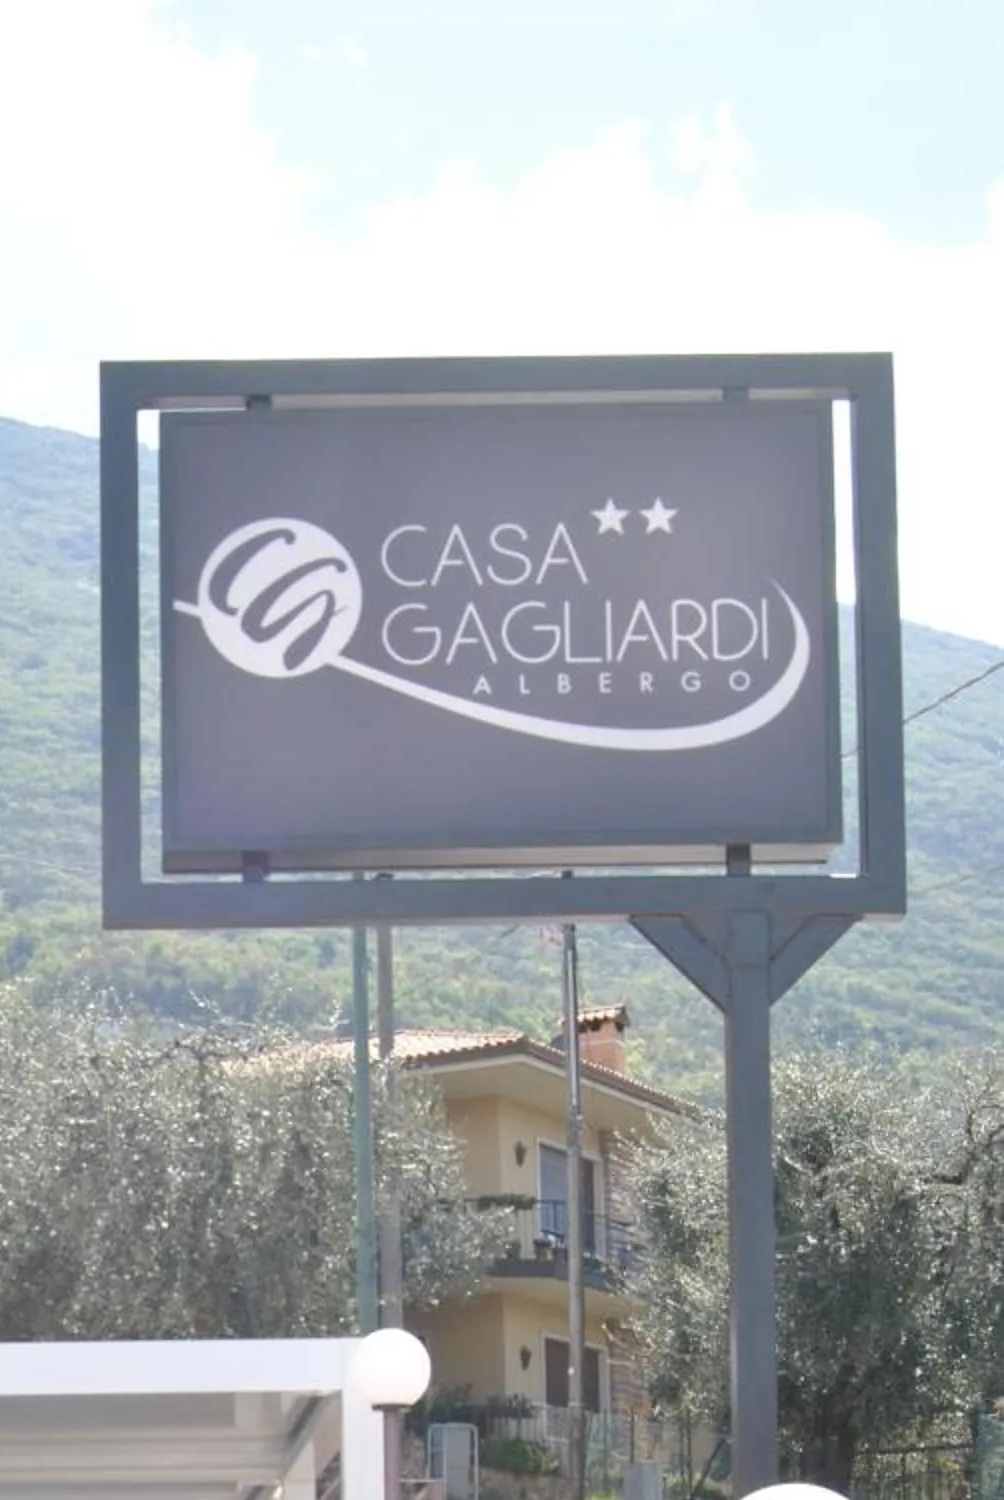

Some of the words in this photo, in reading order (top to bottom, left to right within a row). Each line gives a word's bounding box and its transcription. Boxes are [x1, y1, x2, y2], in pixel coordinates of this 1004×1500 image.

[381, 523, 588, 587] CASA
[382, 597, 770, 665] GAGLIARDI
[473, 670, 750, 695] ALBERGO
